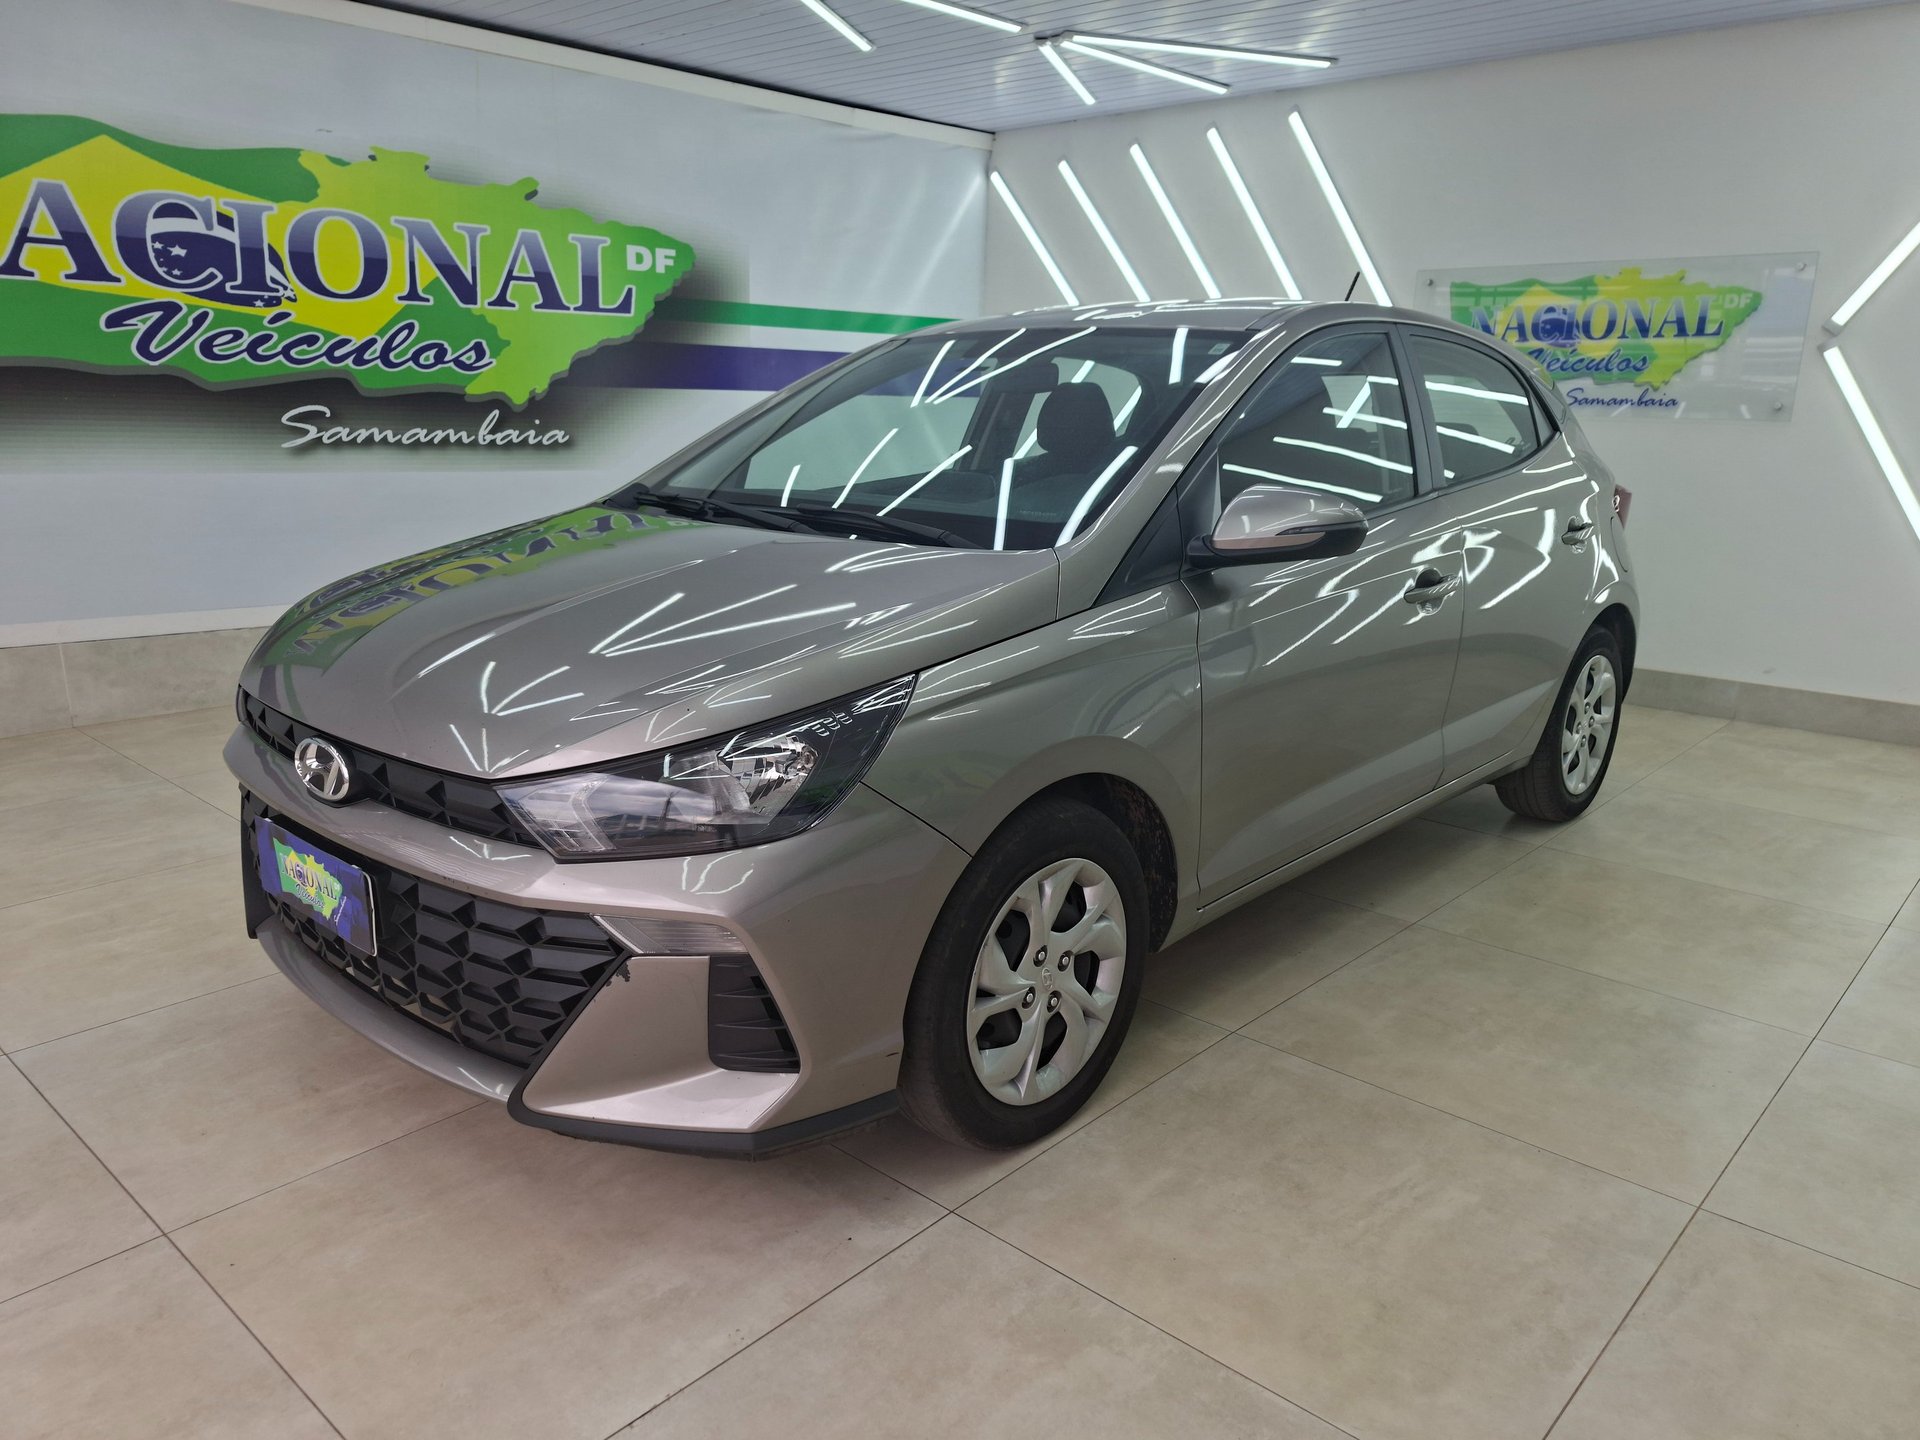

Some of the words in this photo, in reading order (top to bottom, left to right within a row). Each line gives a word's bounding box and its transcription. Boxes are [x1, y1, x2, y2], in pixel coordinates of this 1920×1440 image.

[626, 244, 677, 274] DF
[101, 300, 497, 373] Veículos
[1470, 296, 1725, 343] NACIONAL
[1723, 293, 1753, 309] DF
[1566, 387, 1680, 408] Samambaia
[281, 404, 570, 448] Samambaia
